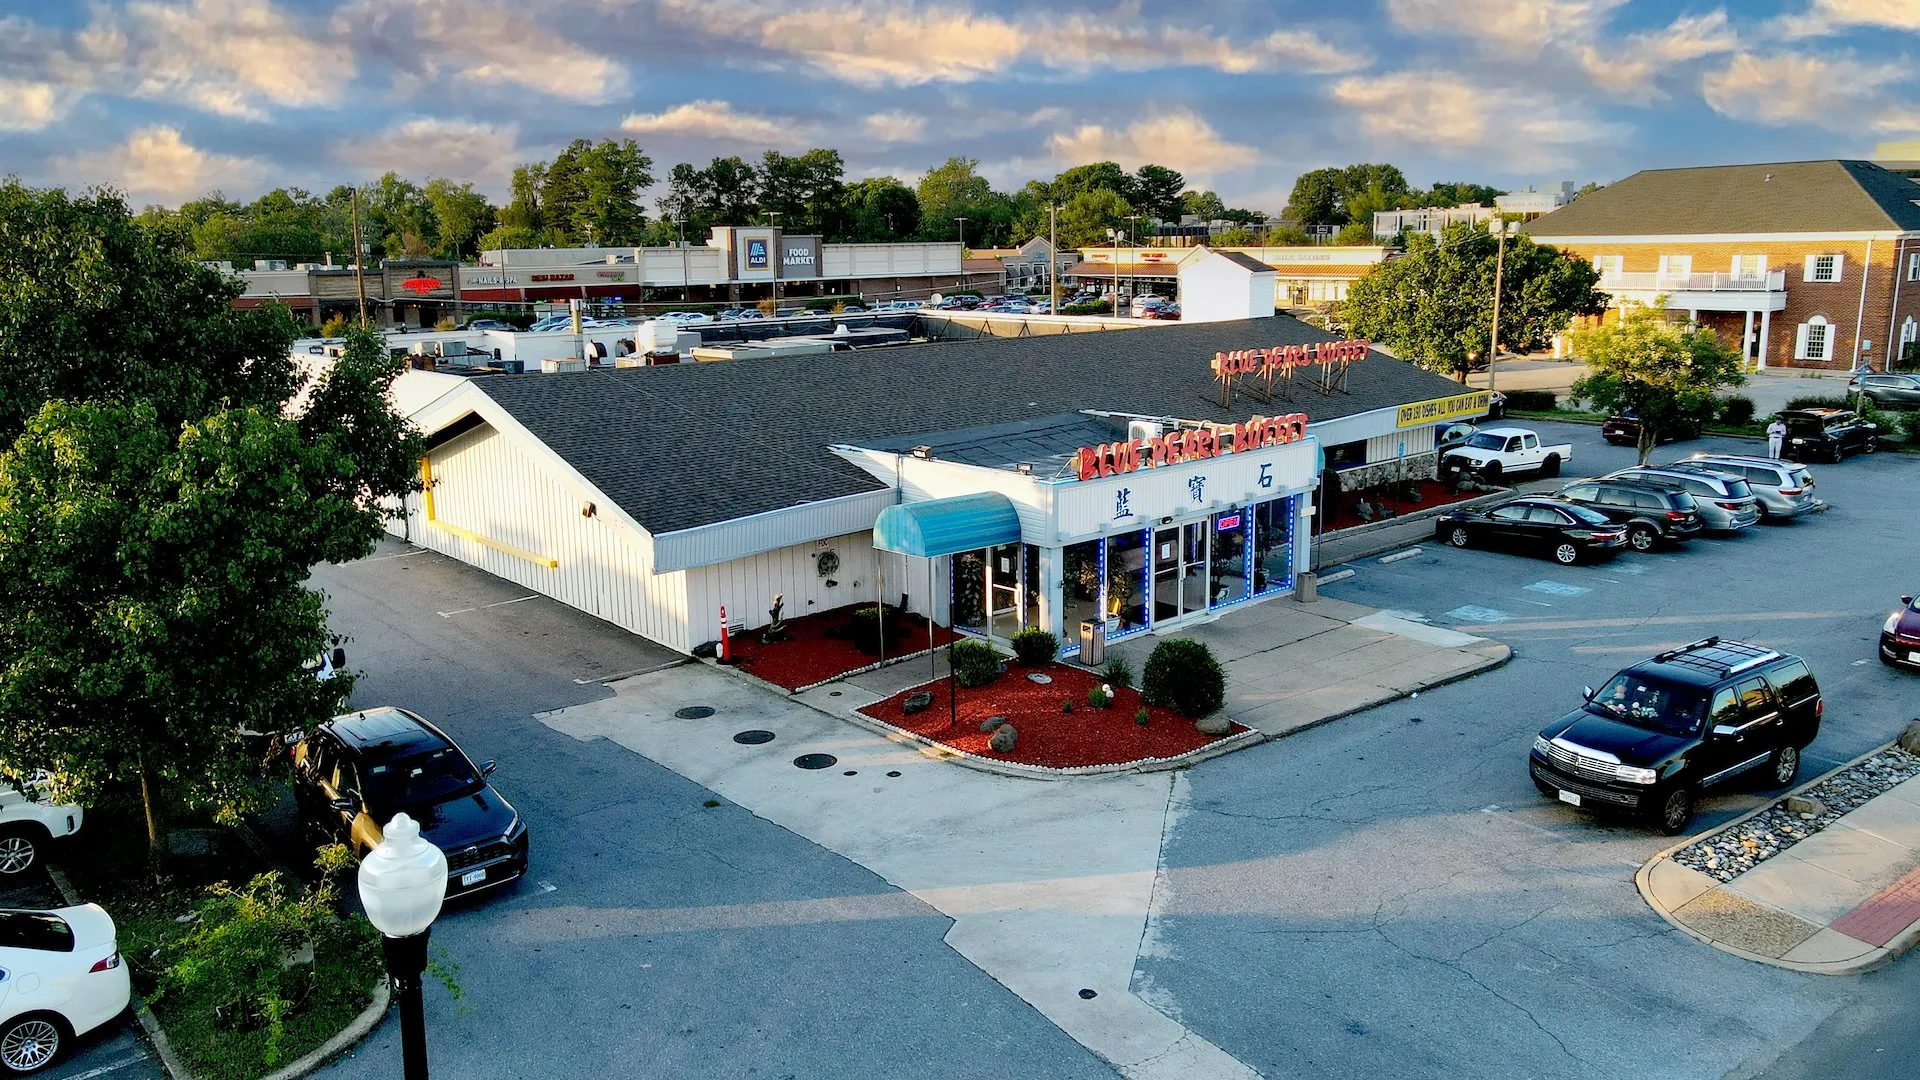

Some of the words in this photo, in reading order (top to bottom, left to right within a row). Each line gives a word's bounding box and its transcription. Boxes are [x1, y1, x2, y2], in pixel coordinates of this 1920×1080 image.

[789, 248, 809, 257] FOOD
[783, 257, 815, 266] MARKET
[478, 277, 496, 285] NAILS
[505, 276, 517, 284] SPA
[531, 274, 548, 282] DESI
[550, 273, 575, 281] BAZAR
[1217, 350, 1258, 376] BLUE
[1261, 345, 1312, 370] PEARL
[1314, 339, 1369, 365] BUFFET
[1401, 409, 1412, 421] OVER
[1422, 404, 1437, 418] DISHES
[1456, 398, 1464, 411] CAN
[1078, 439, 1143, 481] BLUE
[1150, 428, 1223, 469] PEARL
[1233, 413, 1309, 454] BUFFET
[1113, 462, 1273, 521] 藍寶石
[1220, 516, 1238, 528] OPEN
